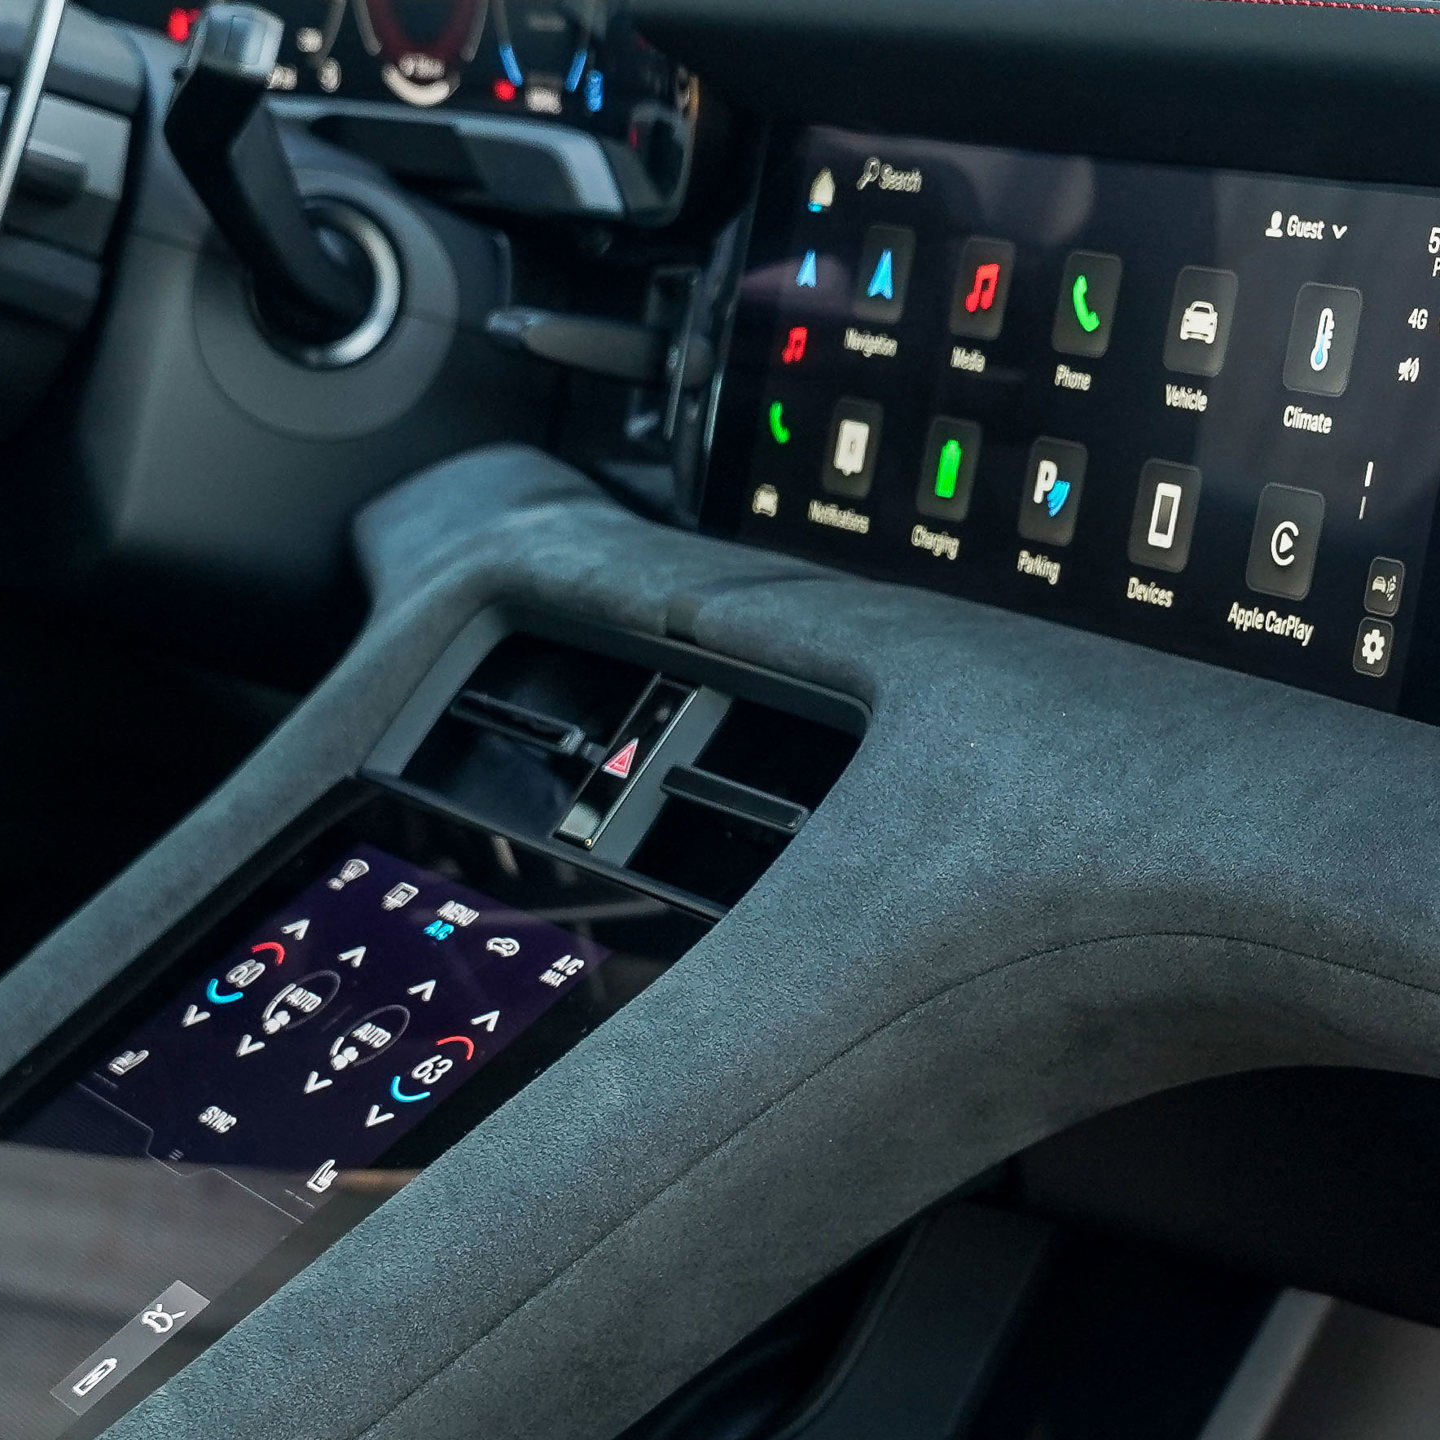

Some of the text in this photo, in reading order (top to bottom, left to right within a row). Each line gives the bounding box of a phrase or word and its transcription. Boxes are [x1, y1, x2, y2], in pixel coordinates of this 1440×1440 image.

[878, 164, 923, 193] Search
[1286, 214, 1325, 240] Guest
[1408, 308, 1428, 330] 4G
[844, 327, 898, 358] Navigation
[950, 345, 986, 373] Media
[1054, 364, 1092, 391] Phone
[1165, 384, 1208, 412] Vehicle
[1283, 405, 1333, 434] Climate
[1033, 460, 1058, 504] P
[911, 525, 960, 560] Charging
[1017, 550, 1061, 585] Parking
[1127, 577, 1174, 608] Devices
[1227, 601, 1314, 647] Apple CarPlay
[423, 919, 455, 940] A/C
[226, 959, 266, 988] 60
[551, 954, 585, 976] A/C
[285, 987, 322, 1013] AUTO
[352, 1021, 392, 1049] AUTO
[411, 1054, 454, 1085] 63
[198, 1105, 238, 1133] SYNC
